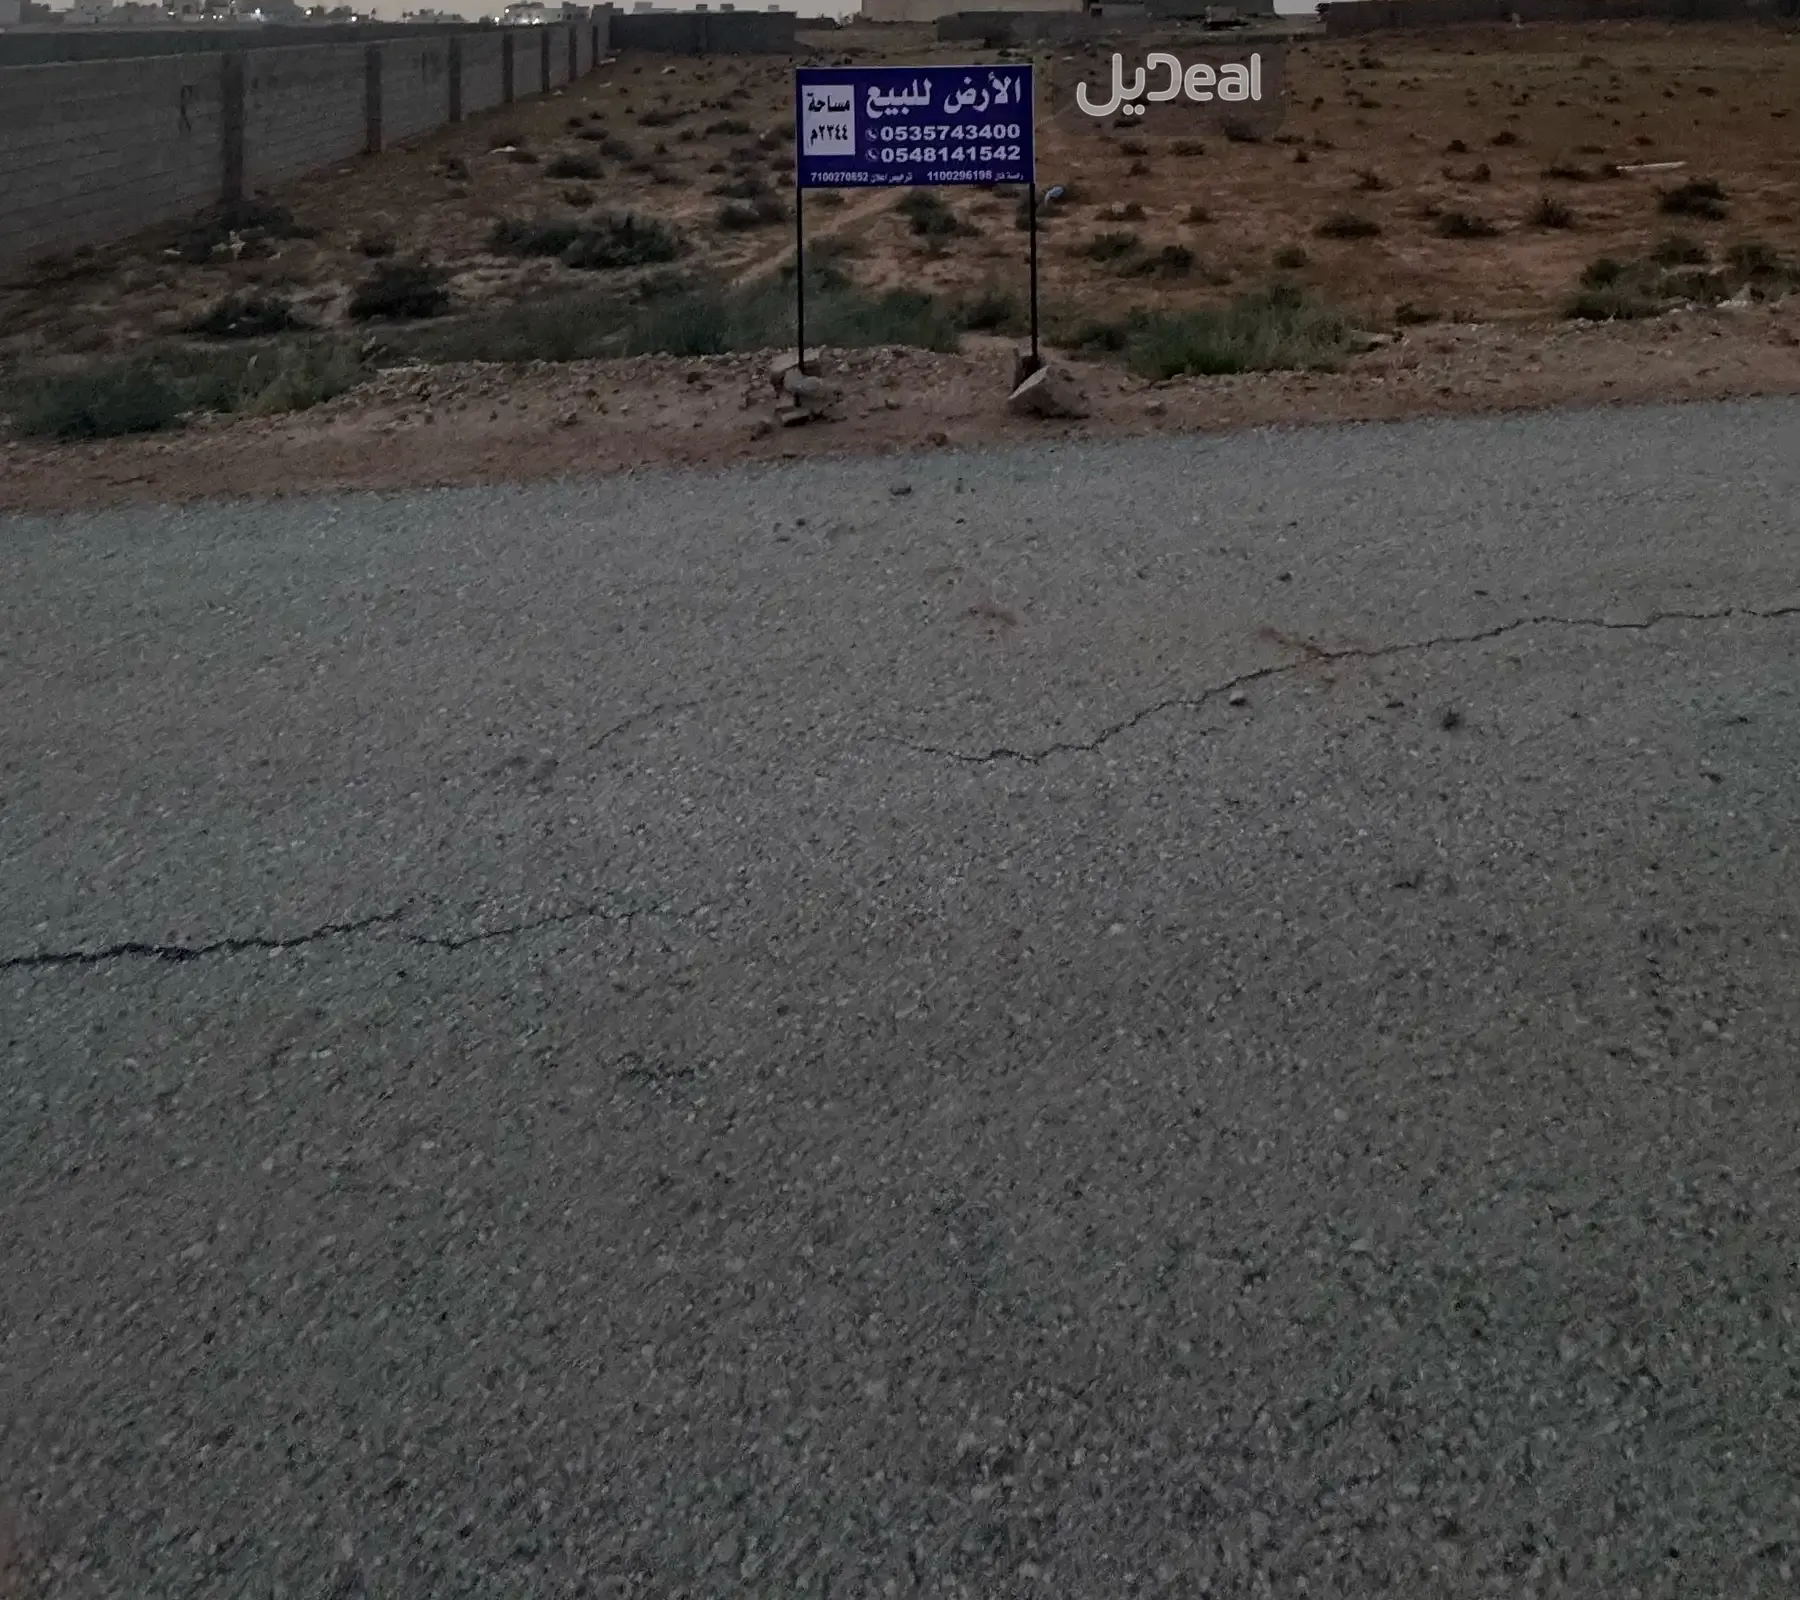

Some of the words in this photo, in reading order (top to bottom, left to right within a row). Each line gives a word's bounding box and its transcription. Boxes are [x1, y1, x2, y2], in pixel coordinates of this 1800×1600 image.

[807, 91, 850, 113] مساحة
[866, 78, 932, 119] للبيع
[943, 71, 1021, 114] الأرض
[880, 123, 1021, 141] 0535743400
[881, 145, 1021, 163] 0548141542
